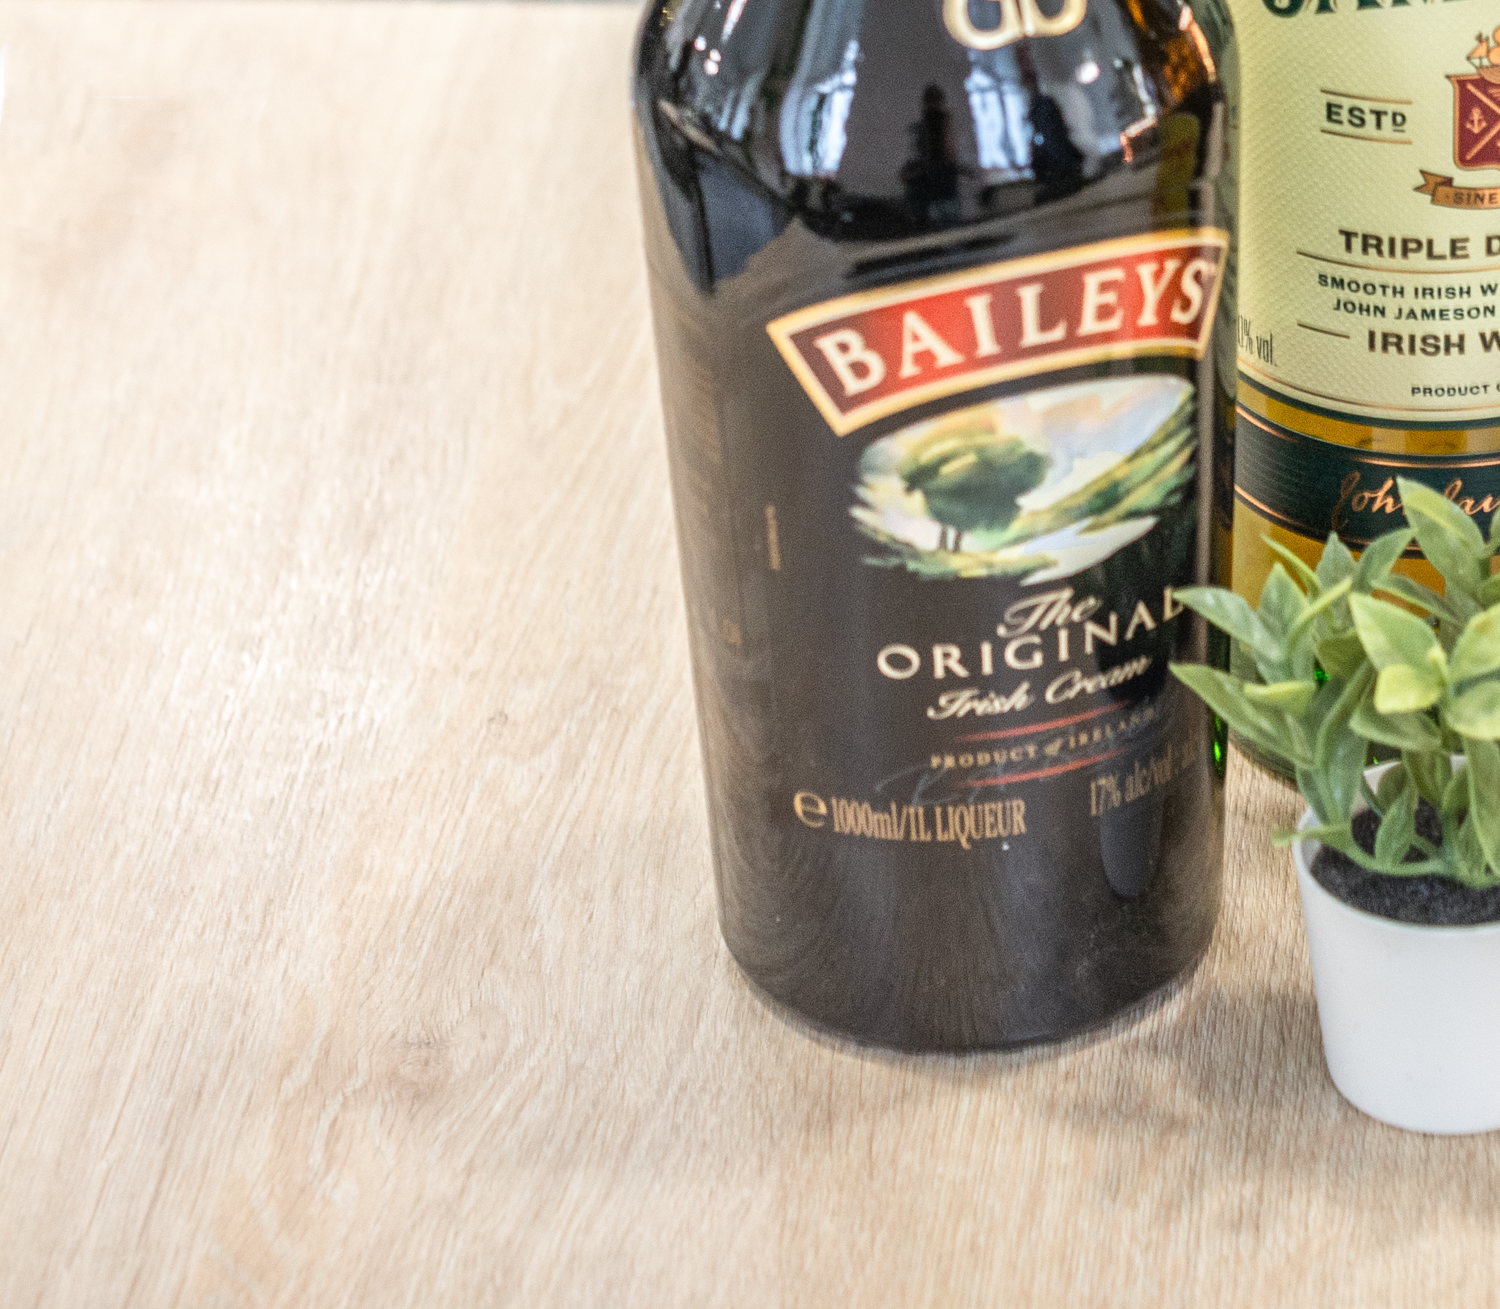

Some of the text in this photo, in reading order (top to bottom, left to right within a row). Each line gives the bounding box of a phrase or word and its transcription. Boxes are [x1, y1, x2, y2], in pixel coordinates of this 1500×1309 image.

[1325, 100, 1408, 133] ESTD
[1338, 228, 1471, 260] TRIPLE
[1317, 272, 1406, 299] SMOOTH
[1413, 281, 1472, 300] IRISH
[1332, 297, 1387, 318] JOHN
[1394, 304, 1496, 322] JAMESON
[814, 256, 1204, 398] BAILEYS
[1367, 328, 1466, 358] IRISH
[1410, 384, 1491, 398] PRODUCT
[996, 585, 1103, 639] The
[877, 586, 1186, 681] ORIGINAL
[926, 654, 1152, 721] Irish Cream
[930, 743, 1038, 769] PRODUCT
[935, 797, 1028, 851] LIQUEUR
